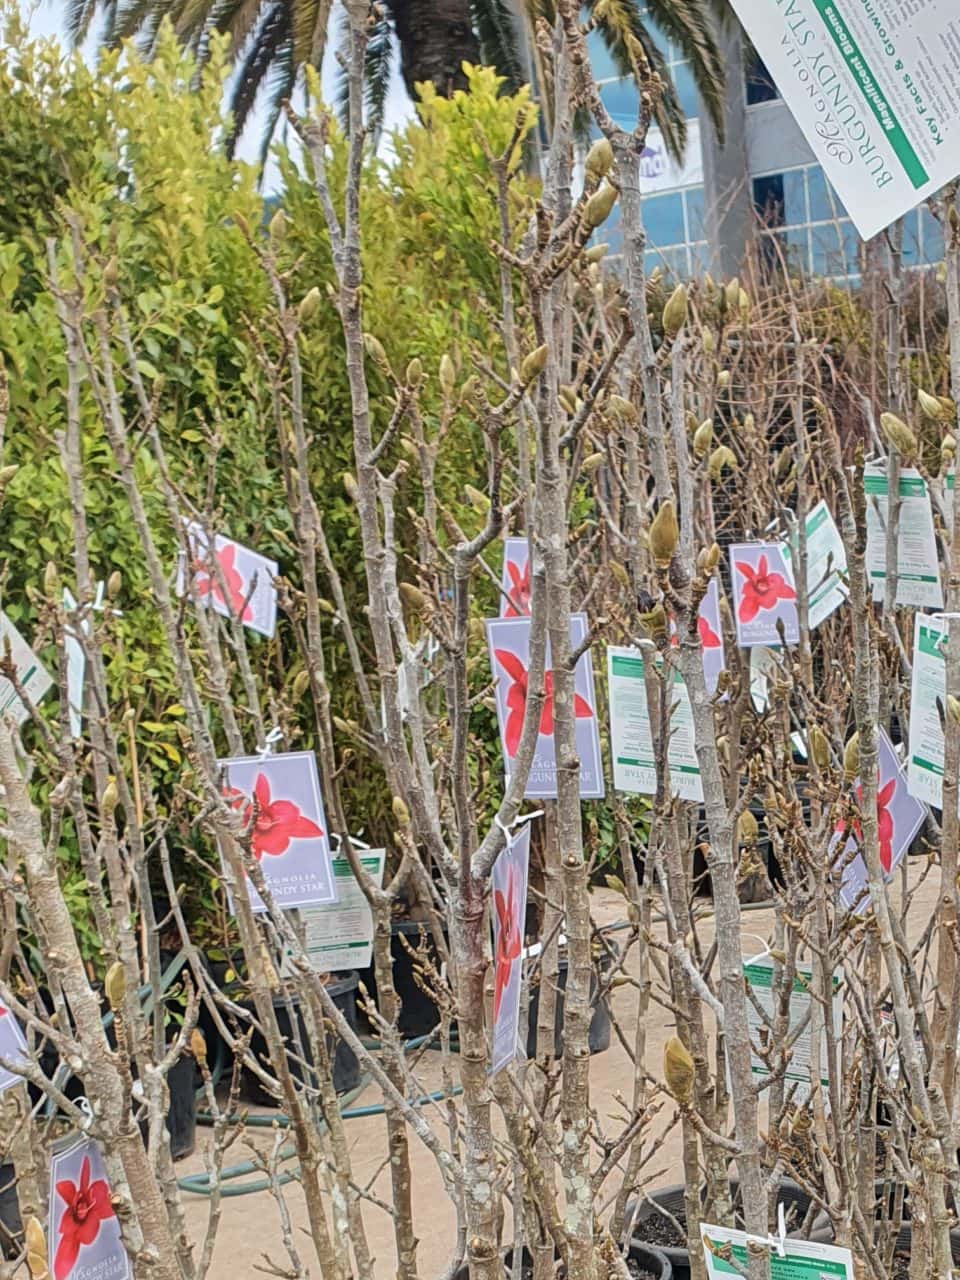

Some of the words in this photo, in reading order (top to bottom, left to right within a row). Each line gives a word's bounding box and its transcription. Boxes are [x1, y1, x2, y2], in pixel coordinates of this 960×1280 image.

[775, 0, 817, 47] STA
[821, 6, 856, 56] Blooms
[892, 59, 905, 72] &
[848, 55, 898, 131] Magnificent
[899, 72, 929, 115] Facts
[806, 48, 896, 189] BURGUNDY
[923, 115, 946, 145] Key
